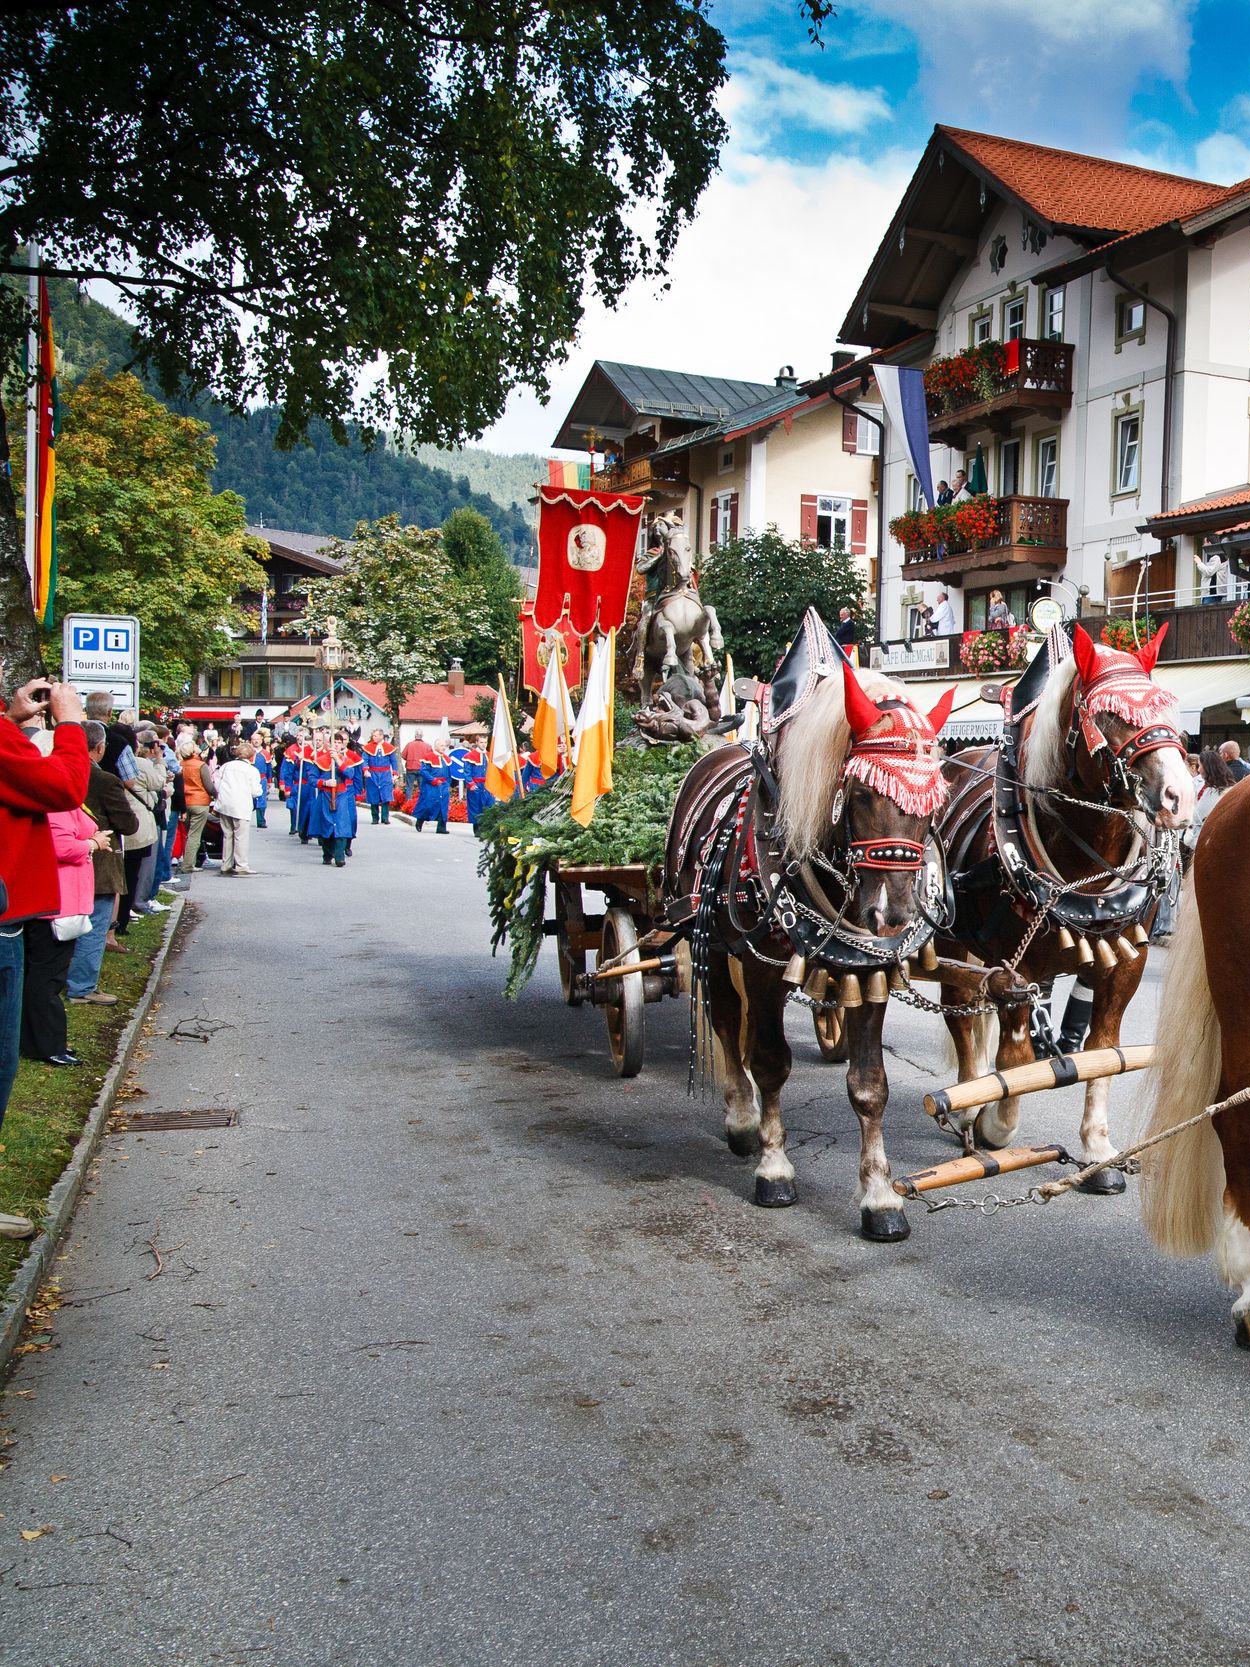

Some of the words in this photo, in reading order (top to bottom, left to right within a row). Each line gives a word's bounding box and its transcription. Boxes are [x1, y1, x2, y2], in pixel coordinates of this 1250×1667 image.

[900, 648, 935, 664] CHIEMGAU
[73, 660, 130, 671] Tourist-Info
[951, 723, 998, 736] HEIGERMOSER
